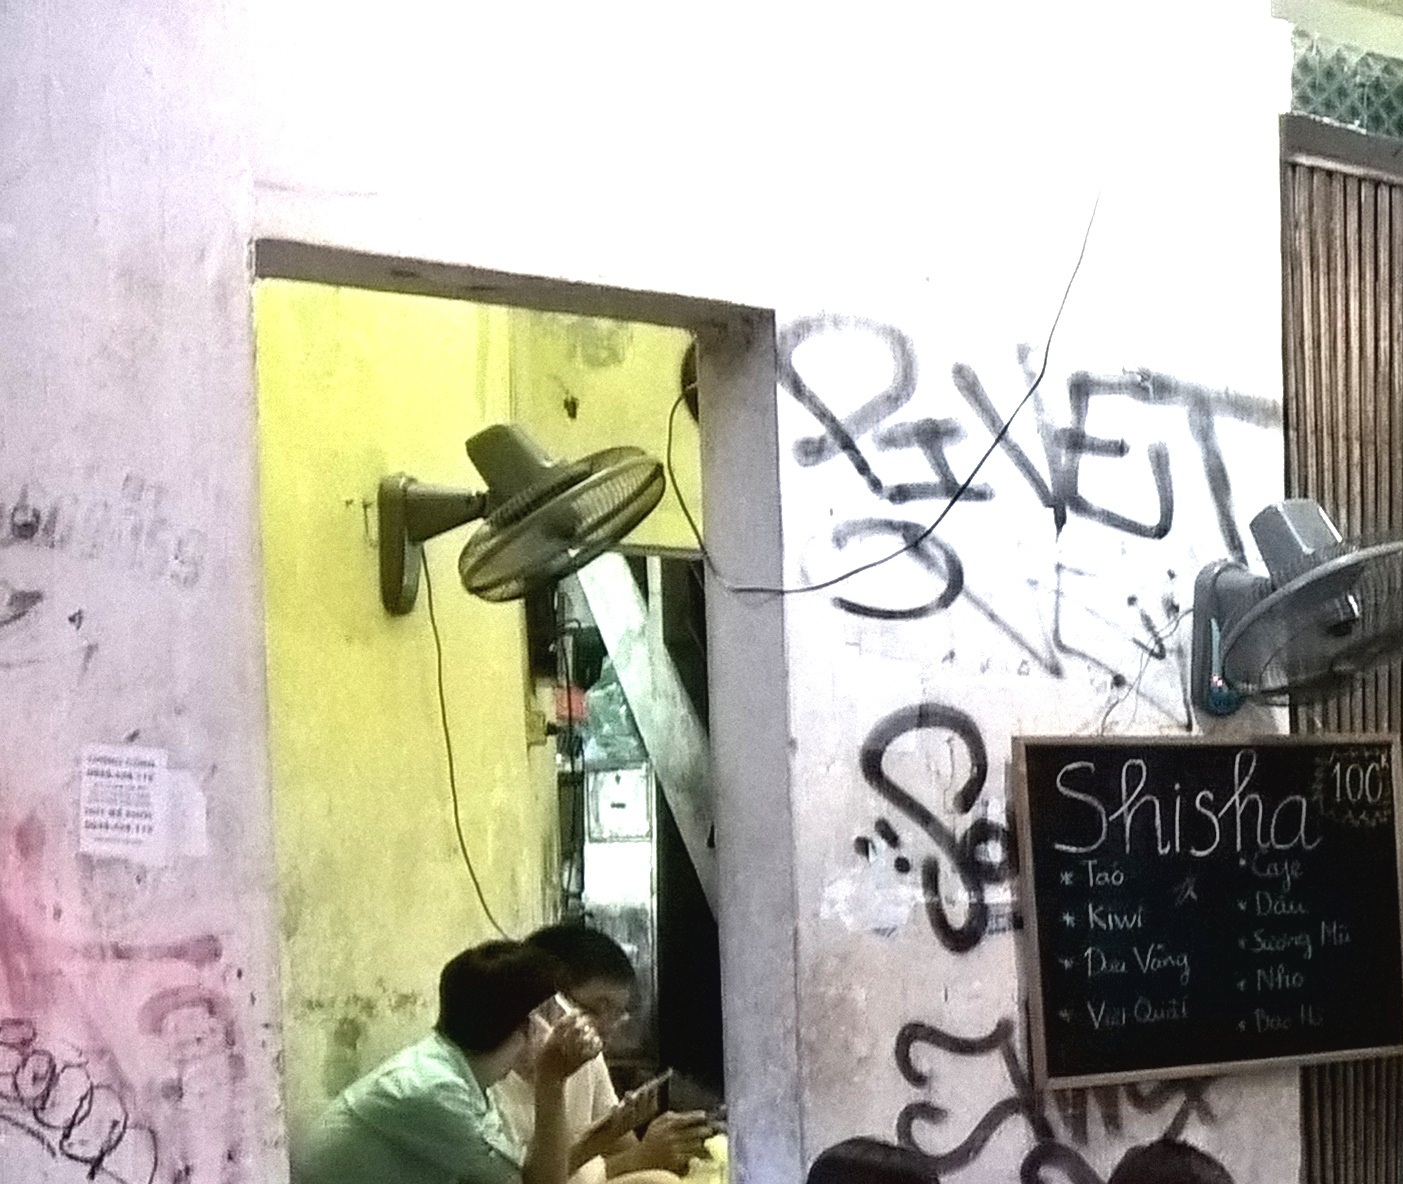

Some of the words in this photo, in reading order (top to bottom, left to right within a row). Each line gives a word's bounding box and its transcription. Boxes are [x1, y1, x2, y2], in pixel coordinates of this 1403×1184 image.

[1054, 748, 1323, 857] Shisha
[1087, 899, 1144, 932] Kiwi
[1256, 963, 1305, 993] Nho
